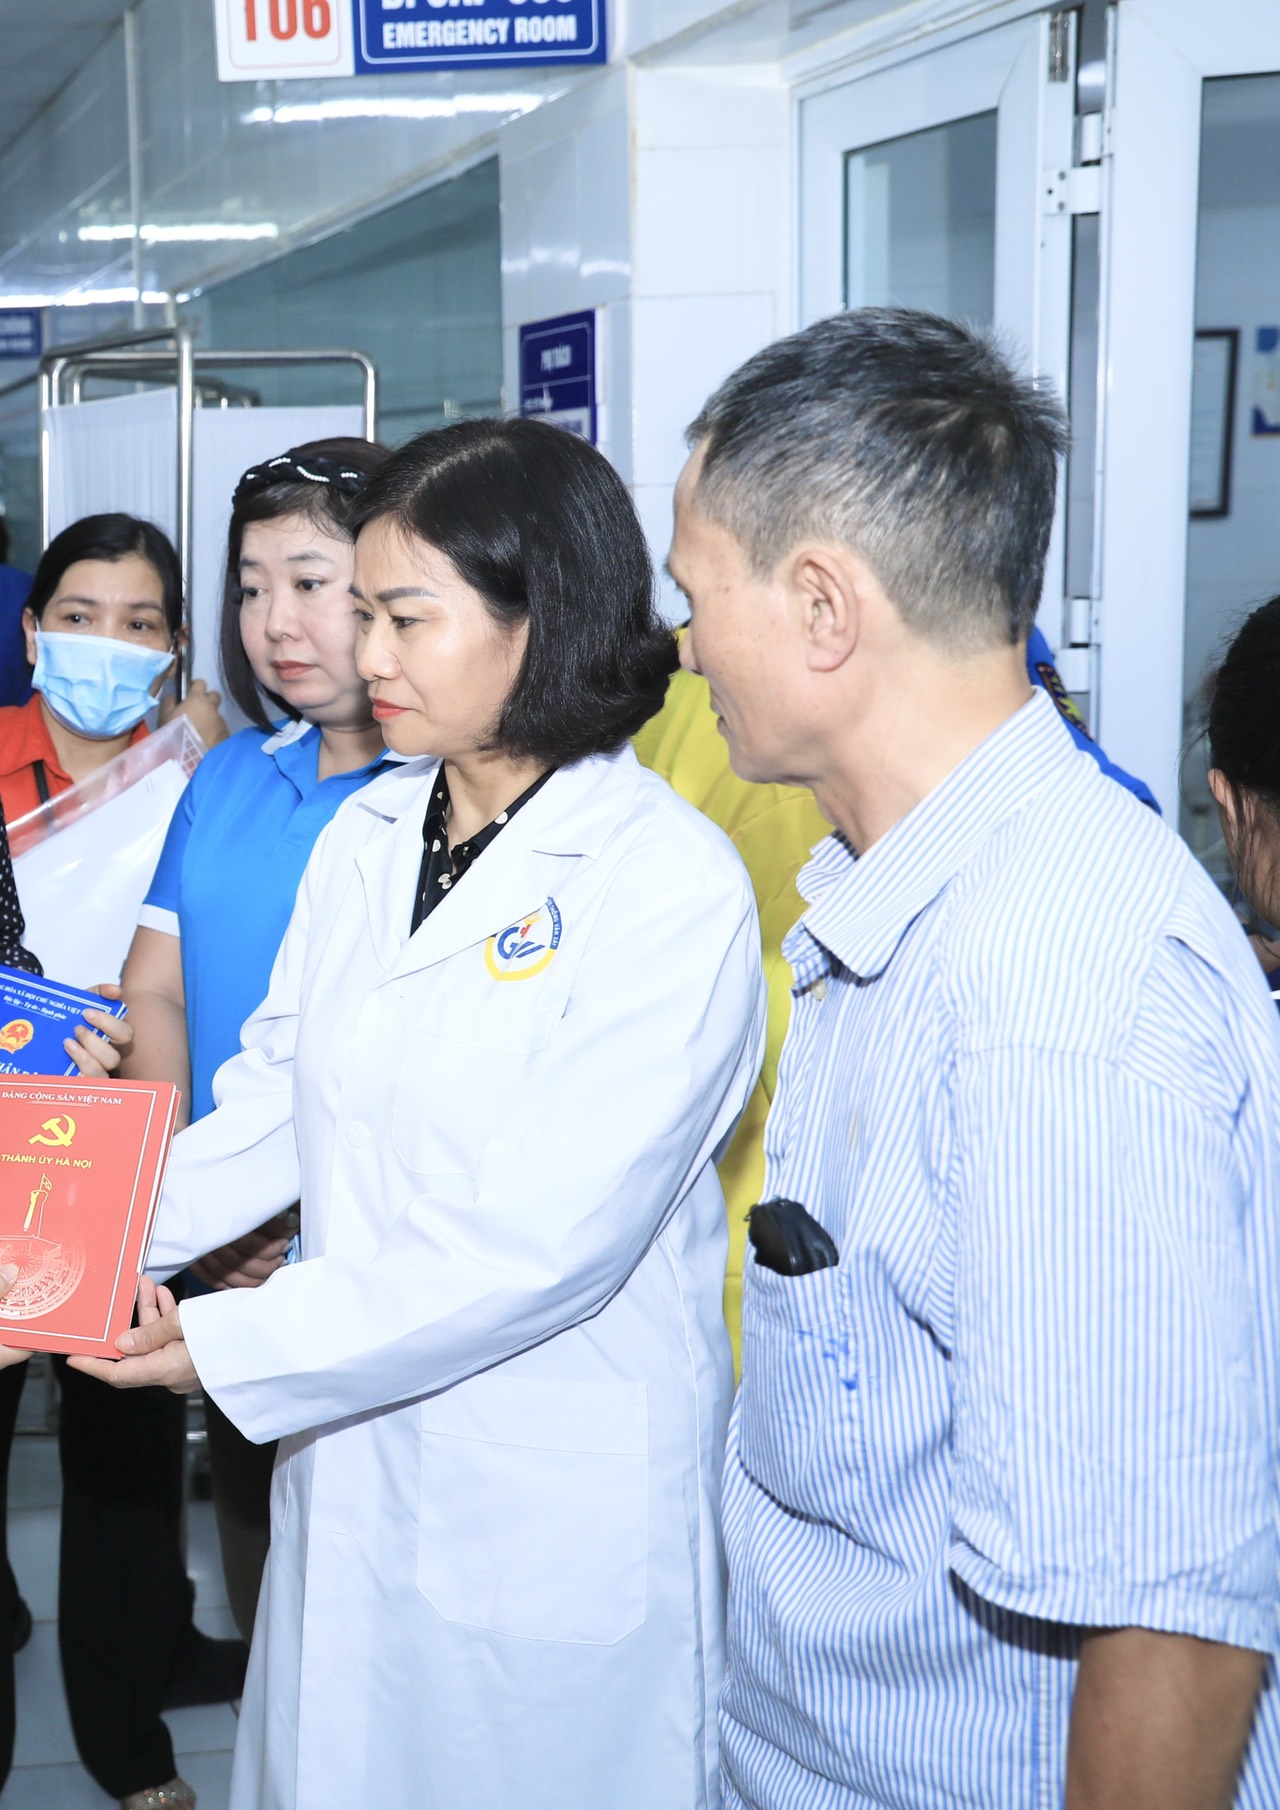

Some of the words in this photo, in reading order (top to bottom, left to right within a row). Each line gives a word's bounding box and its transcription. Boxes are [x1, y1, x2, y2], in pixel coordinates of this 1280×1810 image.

[244, 0, 332, 42] 106
[382, 17, 511, 50] EMERGENCY
[514, 14, 578, 44] ROOM
[1, 1090, 27, 1099] ĐẢNG
[29, 1091, 56, 1102] CỘNG
[56, 1093, 75, 1102] SẢN
[77, 1094, 100, 1104] VIỆT
[99, 1097, 122, 1105] NAM
[1, 1153, 36, 1164] THÀNH
[38, 1154, 53, 1165] ỦY
[55, 1157, 70, 1167] HÀ
[72, 1159, 93, 1170] NỘI
